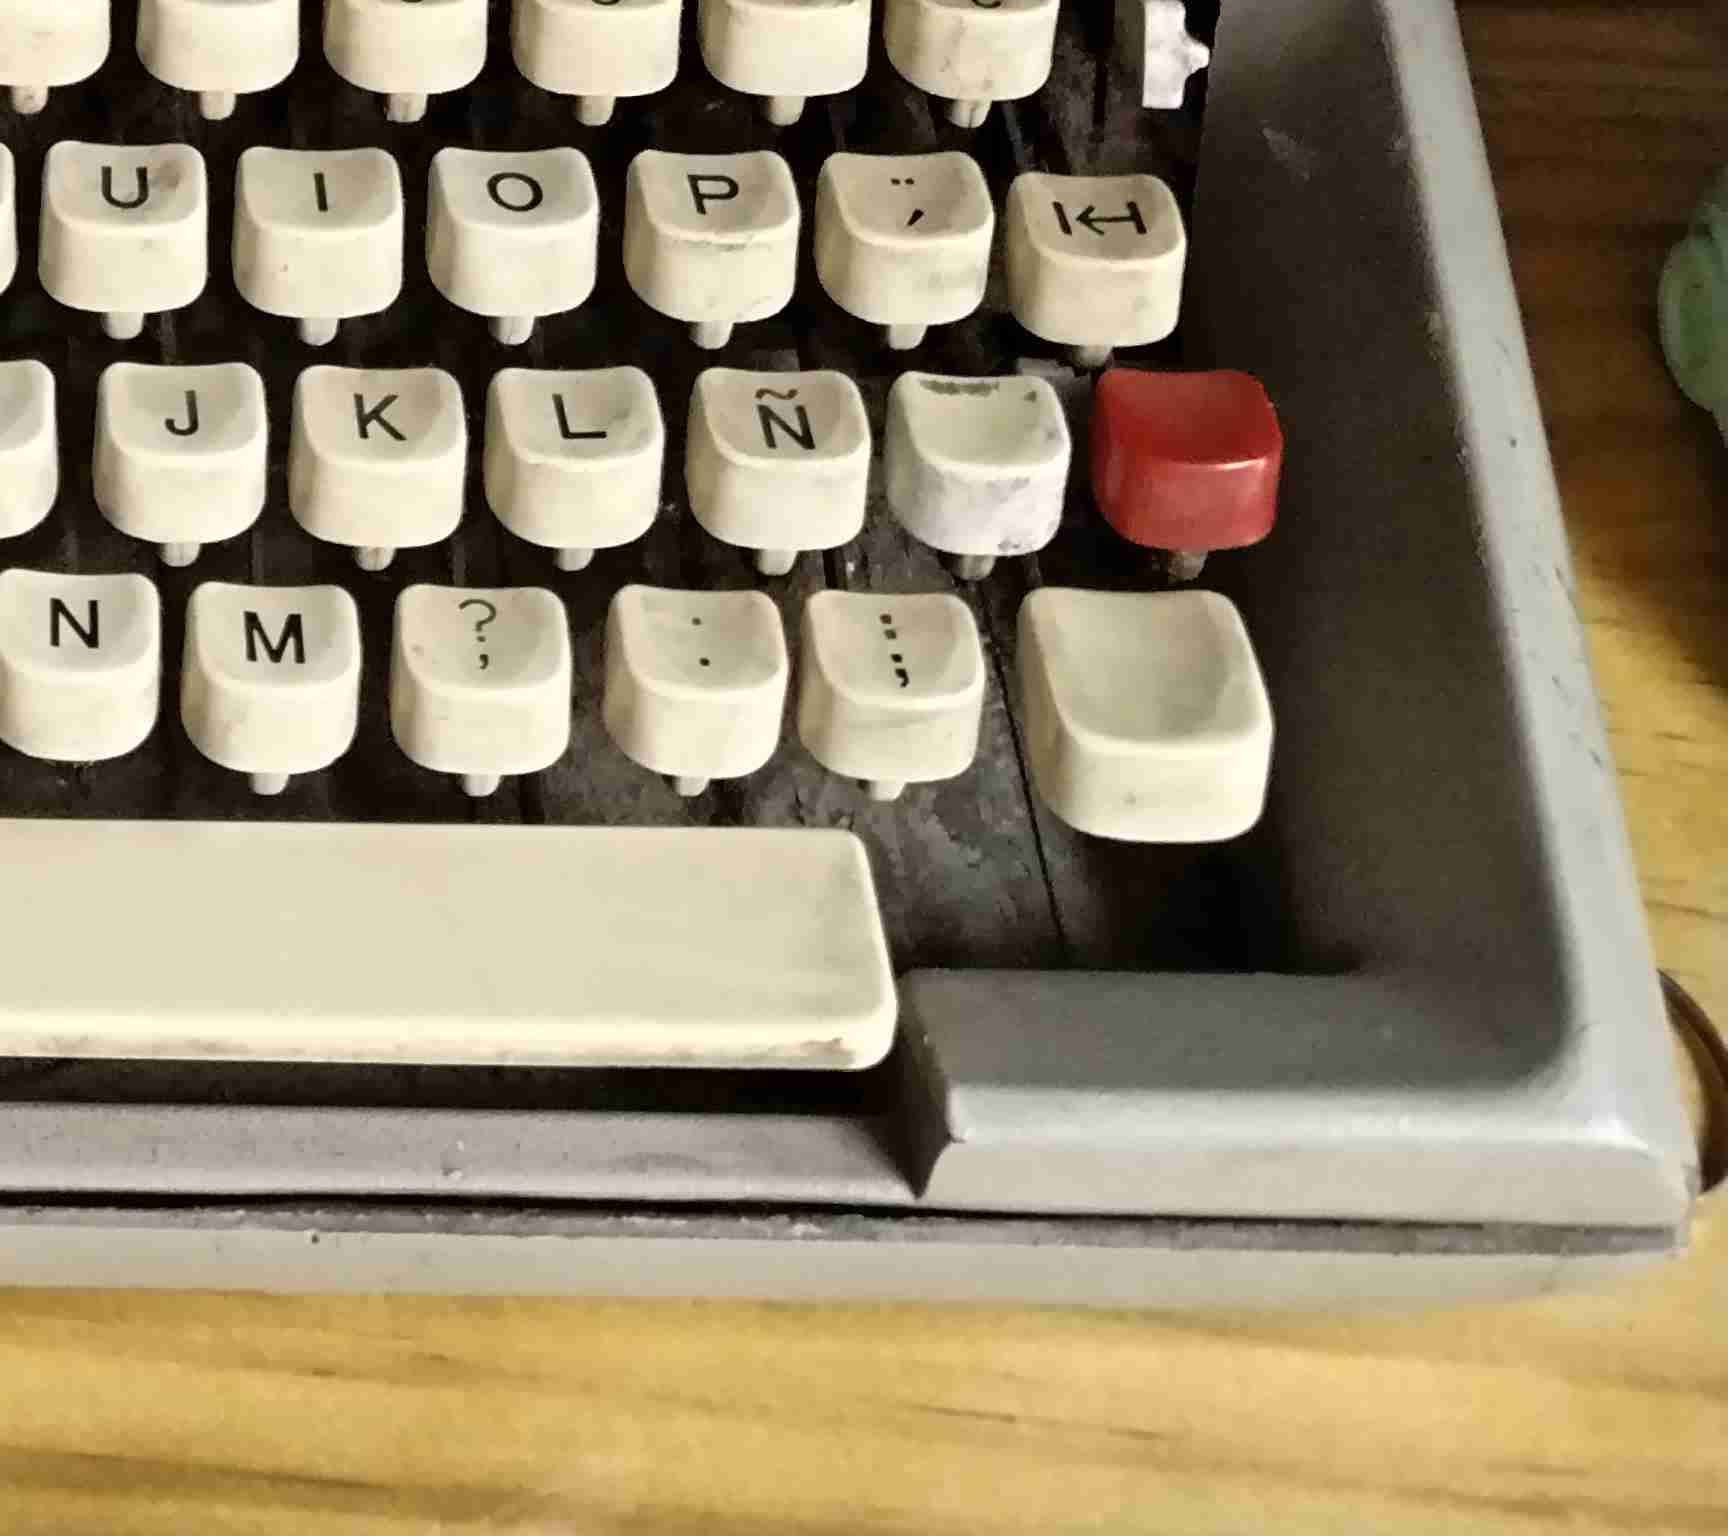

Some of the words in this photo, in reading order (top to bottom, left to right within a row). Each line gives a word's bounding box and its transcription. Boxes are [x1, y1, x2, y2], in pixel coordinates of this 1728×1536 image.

[101, 166, 149, 210] U
[313, 172, 329, 213] I
[486, 172, 544, 212] O
[687, 174, 740, 216] P
[164, 389, 200, 437] J
[353, 393, 407, 442] K
[552, 394, 608, 440] L
[755, 388, 816, 451] Ñ
[50, 597, 100, 649] N
[244, 610, 306, 665] M
